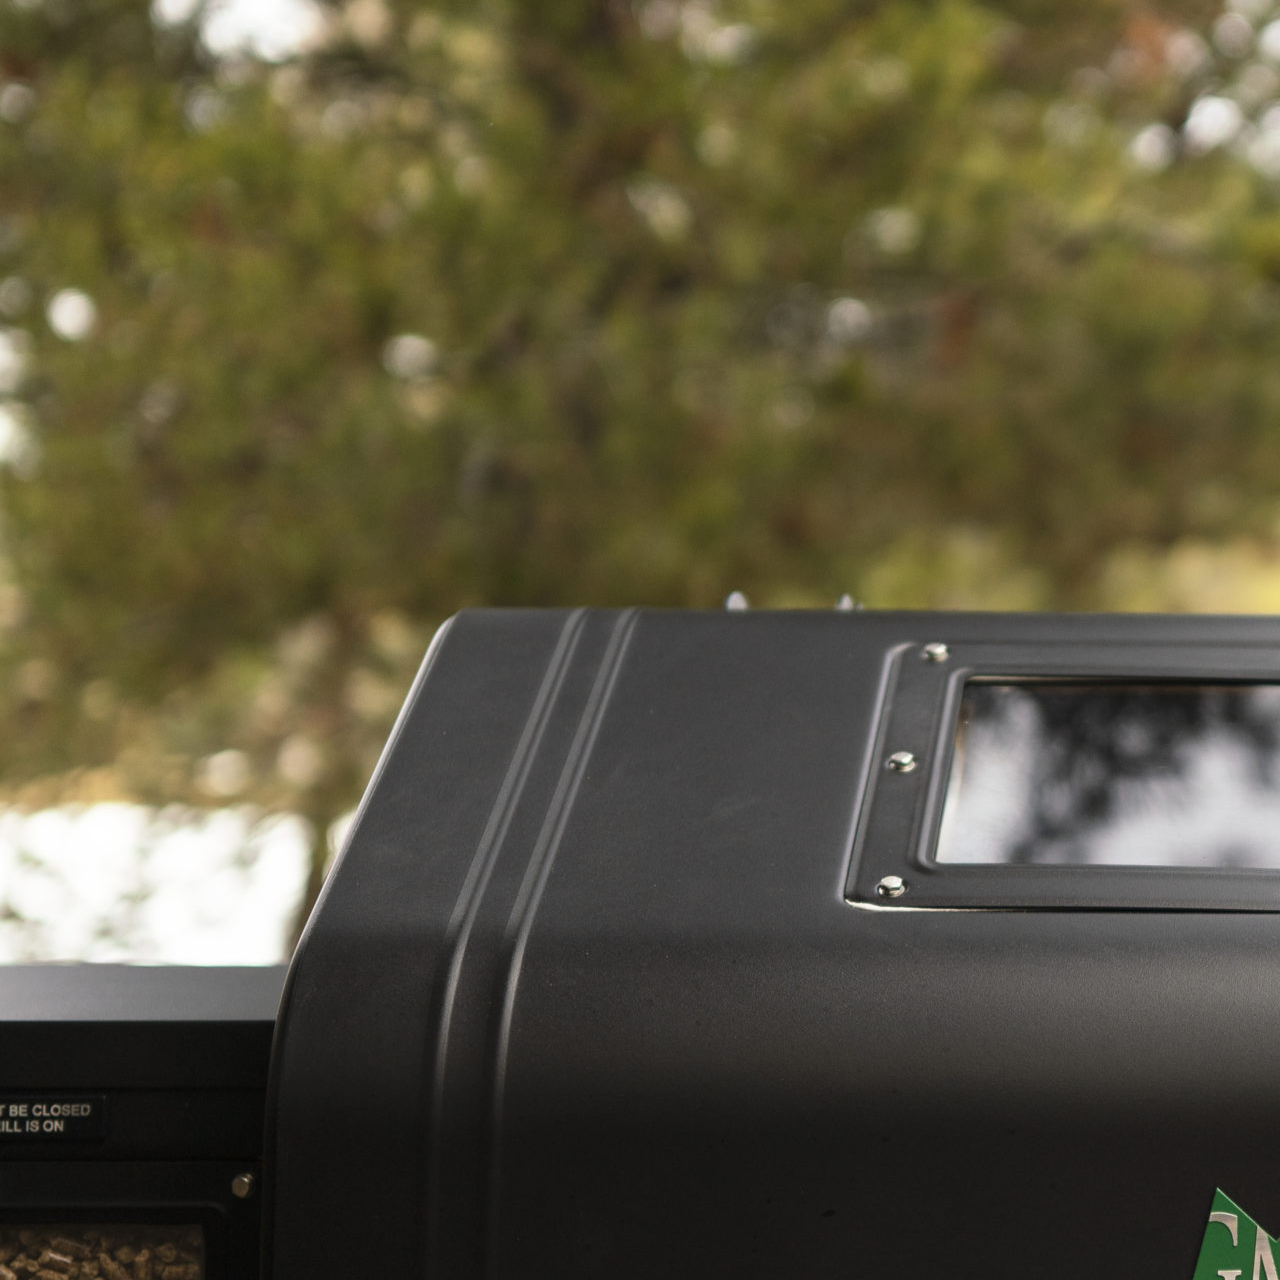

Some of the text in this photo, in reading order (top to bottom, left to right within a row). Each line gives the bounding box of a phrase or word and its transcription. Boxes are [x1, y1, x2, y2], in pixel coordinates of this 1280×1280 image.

[9, 1104, 28, 1117] BE
[32, 1104, 91, 1117] CLOSED
[0, 1120, 65, 1133] ILL IS ON
